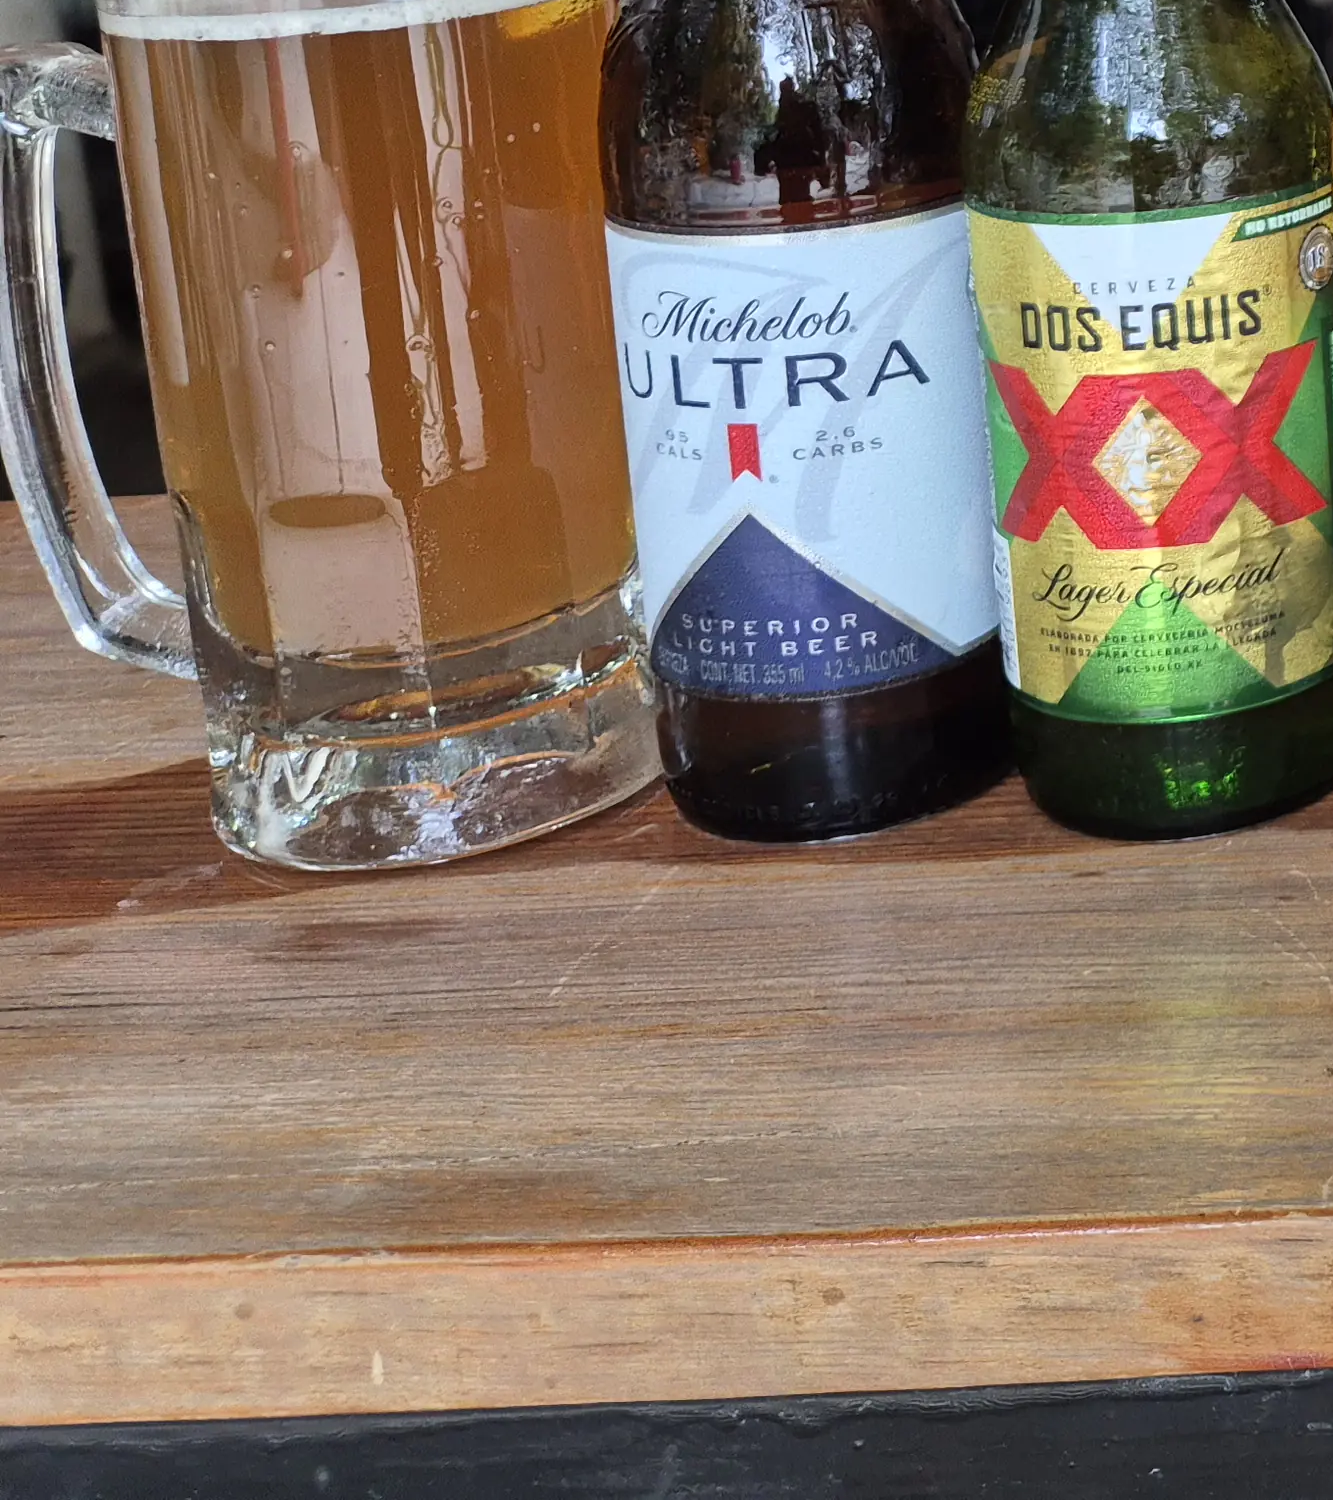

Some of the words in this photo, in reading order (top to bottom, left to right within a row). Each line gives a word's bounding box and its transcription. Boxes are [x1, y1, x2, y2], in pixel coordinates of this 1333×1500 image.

[1244, 220, 1266, 236] NO
[1072, 277, 1198, 295] CERVEZA
[641, 290, 852, 344] Michelob
[1020, 301, 1103, 352] DOS
[1120, 288, 1262, 351] EQUIS
[623, 338, 932, 410] ULTRA
[665, 429, 689, 444] 95
[815, 426, 856, 442] 2.6
[987, 338, 1330, 550] XX
[656, 442, 703, 461] CALS
[792, 437, 884, 461] CARBS
[1032, 562, 1132, 624] Lager
[1129, 547, 1285, 615] Especial
[682, 612, 858, 637] SUPERIOR
[673, 633, 757, 658] LIGHT
[781, 631, 878, 657] BEER
[1040, 628, 1099, 644] ELABORADA
[1104, 633, 1128, 644] POR
[1097, 648, 1130, 659] PARA
[763, 663, 786, 684] 355
